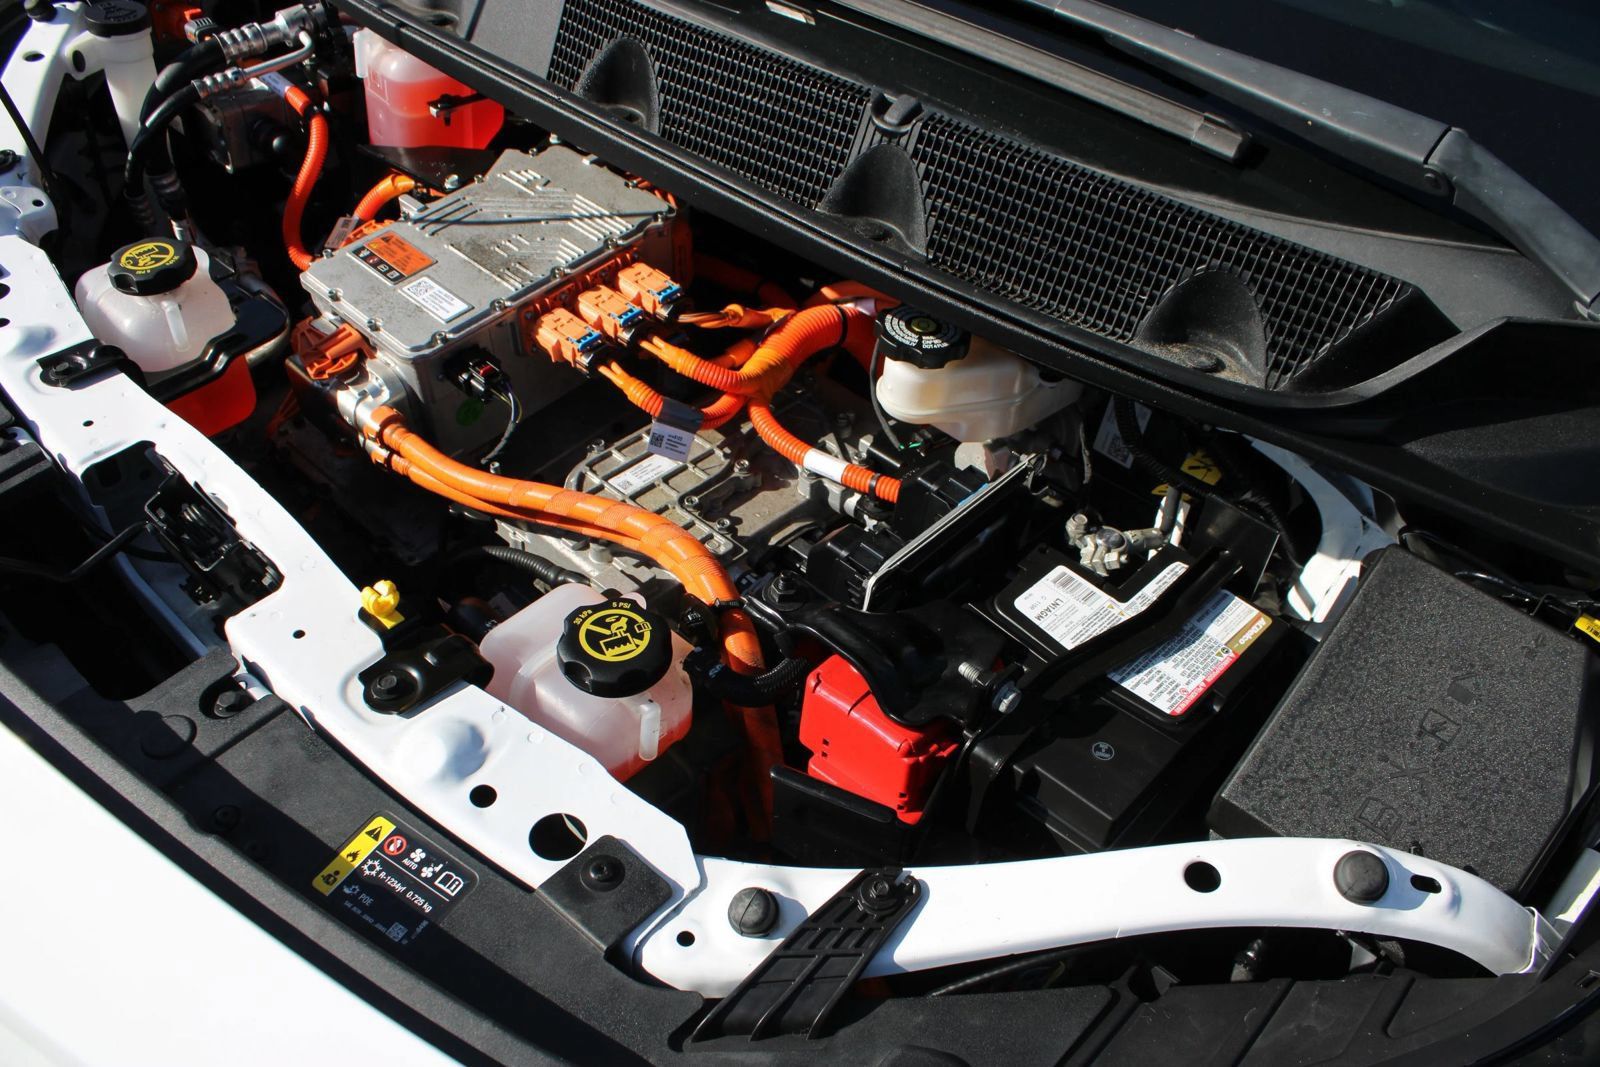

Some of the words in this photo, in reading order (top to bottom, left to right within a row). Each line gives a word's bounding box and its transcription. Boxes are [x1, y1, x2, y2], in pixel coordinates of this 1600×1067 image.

[573, 617, 581, 625] 35
[579, 609, 592, 619] kPa
[1236, 617, 1269, 646] ACDelco
[402, 858, 418, 870] AUTO
[358, 893, 374, 906] POE
[378, 871, 406, 894] R-1234yf
[406, 890, 424, 907] 0.725
[423, 901, 433, 913] kg
